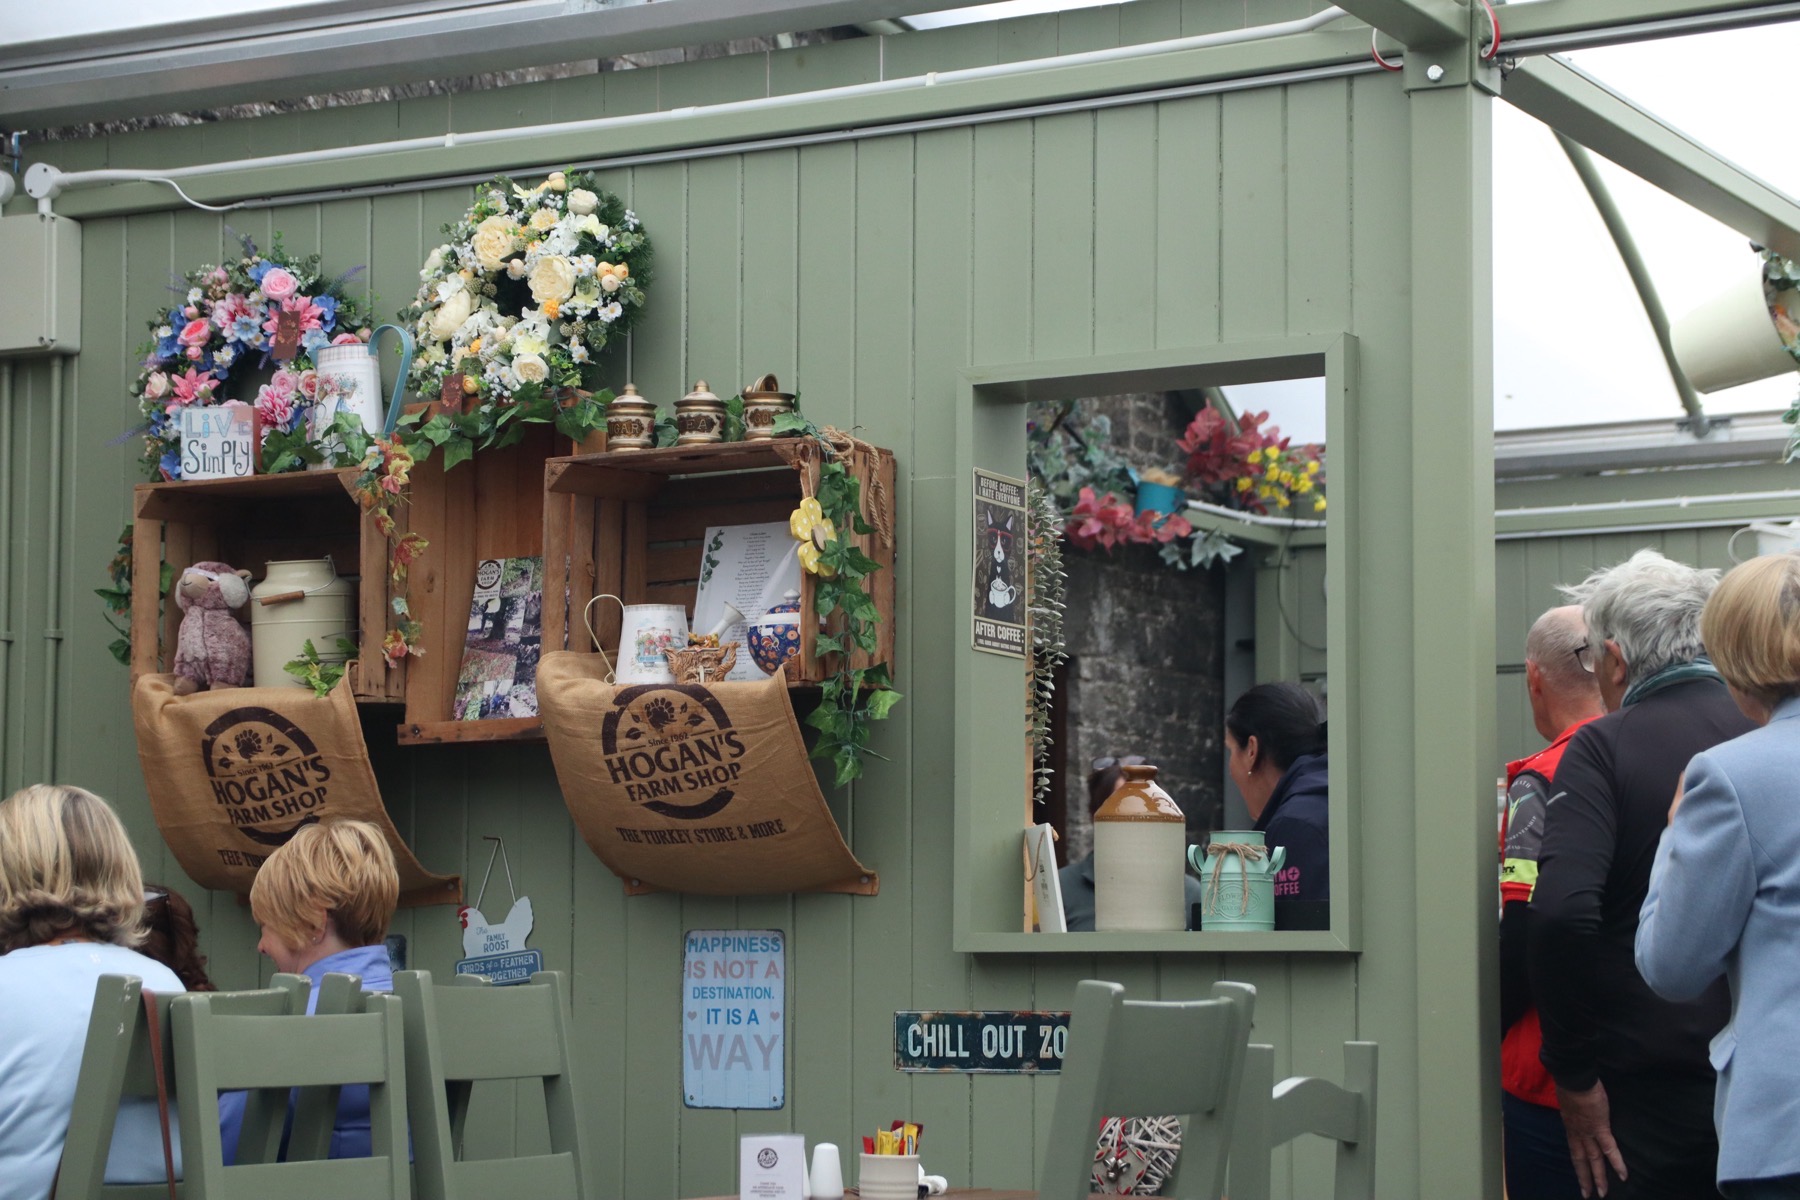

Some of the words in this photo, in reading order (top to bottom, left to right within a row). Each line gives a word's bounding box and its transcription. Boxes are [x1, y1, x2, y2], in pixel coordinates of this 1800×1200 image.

[980, 477, 998, 490] BEFORE
[982, 487, 995, 499] HATE
[995, 490, 1020, 506] EVERYONE
[976, 621, 996, 638] AFTER
[648, 737, 669, 747] Since
[670, 732, 689, 745] 1962
[605, 730, 746, 784] HOGAN'S
[210, 755, 331, 806] HOGAN'S
[625, 775, 684, 801] FARM
[683, 762, 742, 791] SHOP
[226, 805, 273, 824] FARM
[272, 786, 328, 818] SHOP
[616, 827, 642, 843] THE
[640, 828, 693, 845] TURKEY
[693, 826, 737, 843] STORE
[738, 825, 749, 840] &
[748, 818, 787, 839] MORE
[217, 849, 243, 866] THE
[1274, 882, 1300, 896] OFFEE
[486, 933, 505, 942] FAMILY
[687, 936, 781, 953] HAPPINESS
[483, 940, 509, 953] ROOST
[500, 955, 534, 968] FEATHER
[687, 960, 706, 979] IS
[713, 960, 758, 979] NOT
[764, 960, 780, 979] A
[488, 967, 527, 981] TOGETHER
[692, 986, 775, 1000] DESTINATION.
[706, 1008, 722, 1025] IT
[726, 1008, 742, 1025] IS
[746, 1008, 760, 1025] A
[907, 1023, 970, 1058] CHILL
[981, 1024, 1027, 1059] OUT
[1039, 1025, 1069, 1060] ZO
[687, 1033, 780, 1072] WAY
